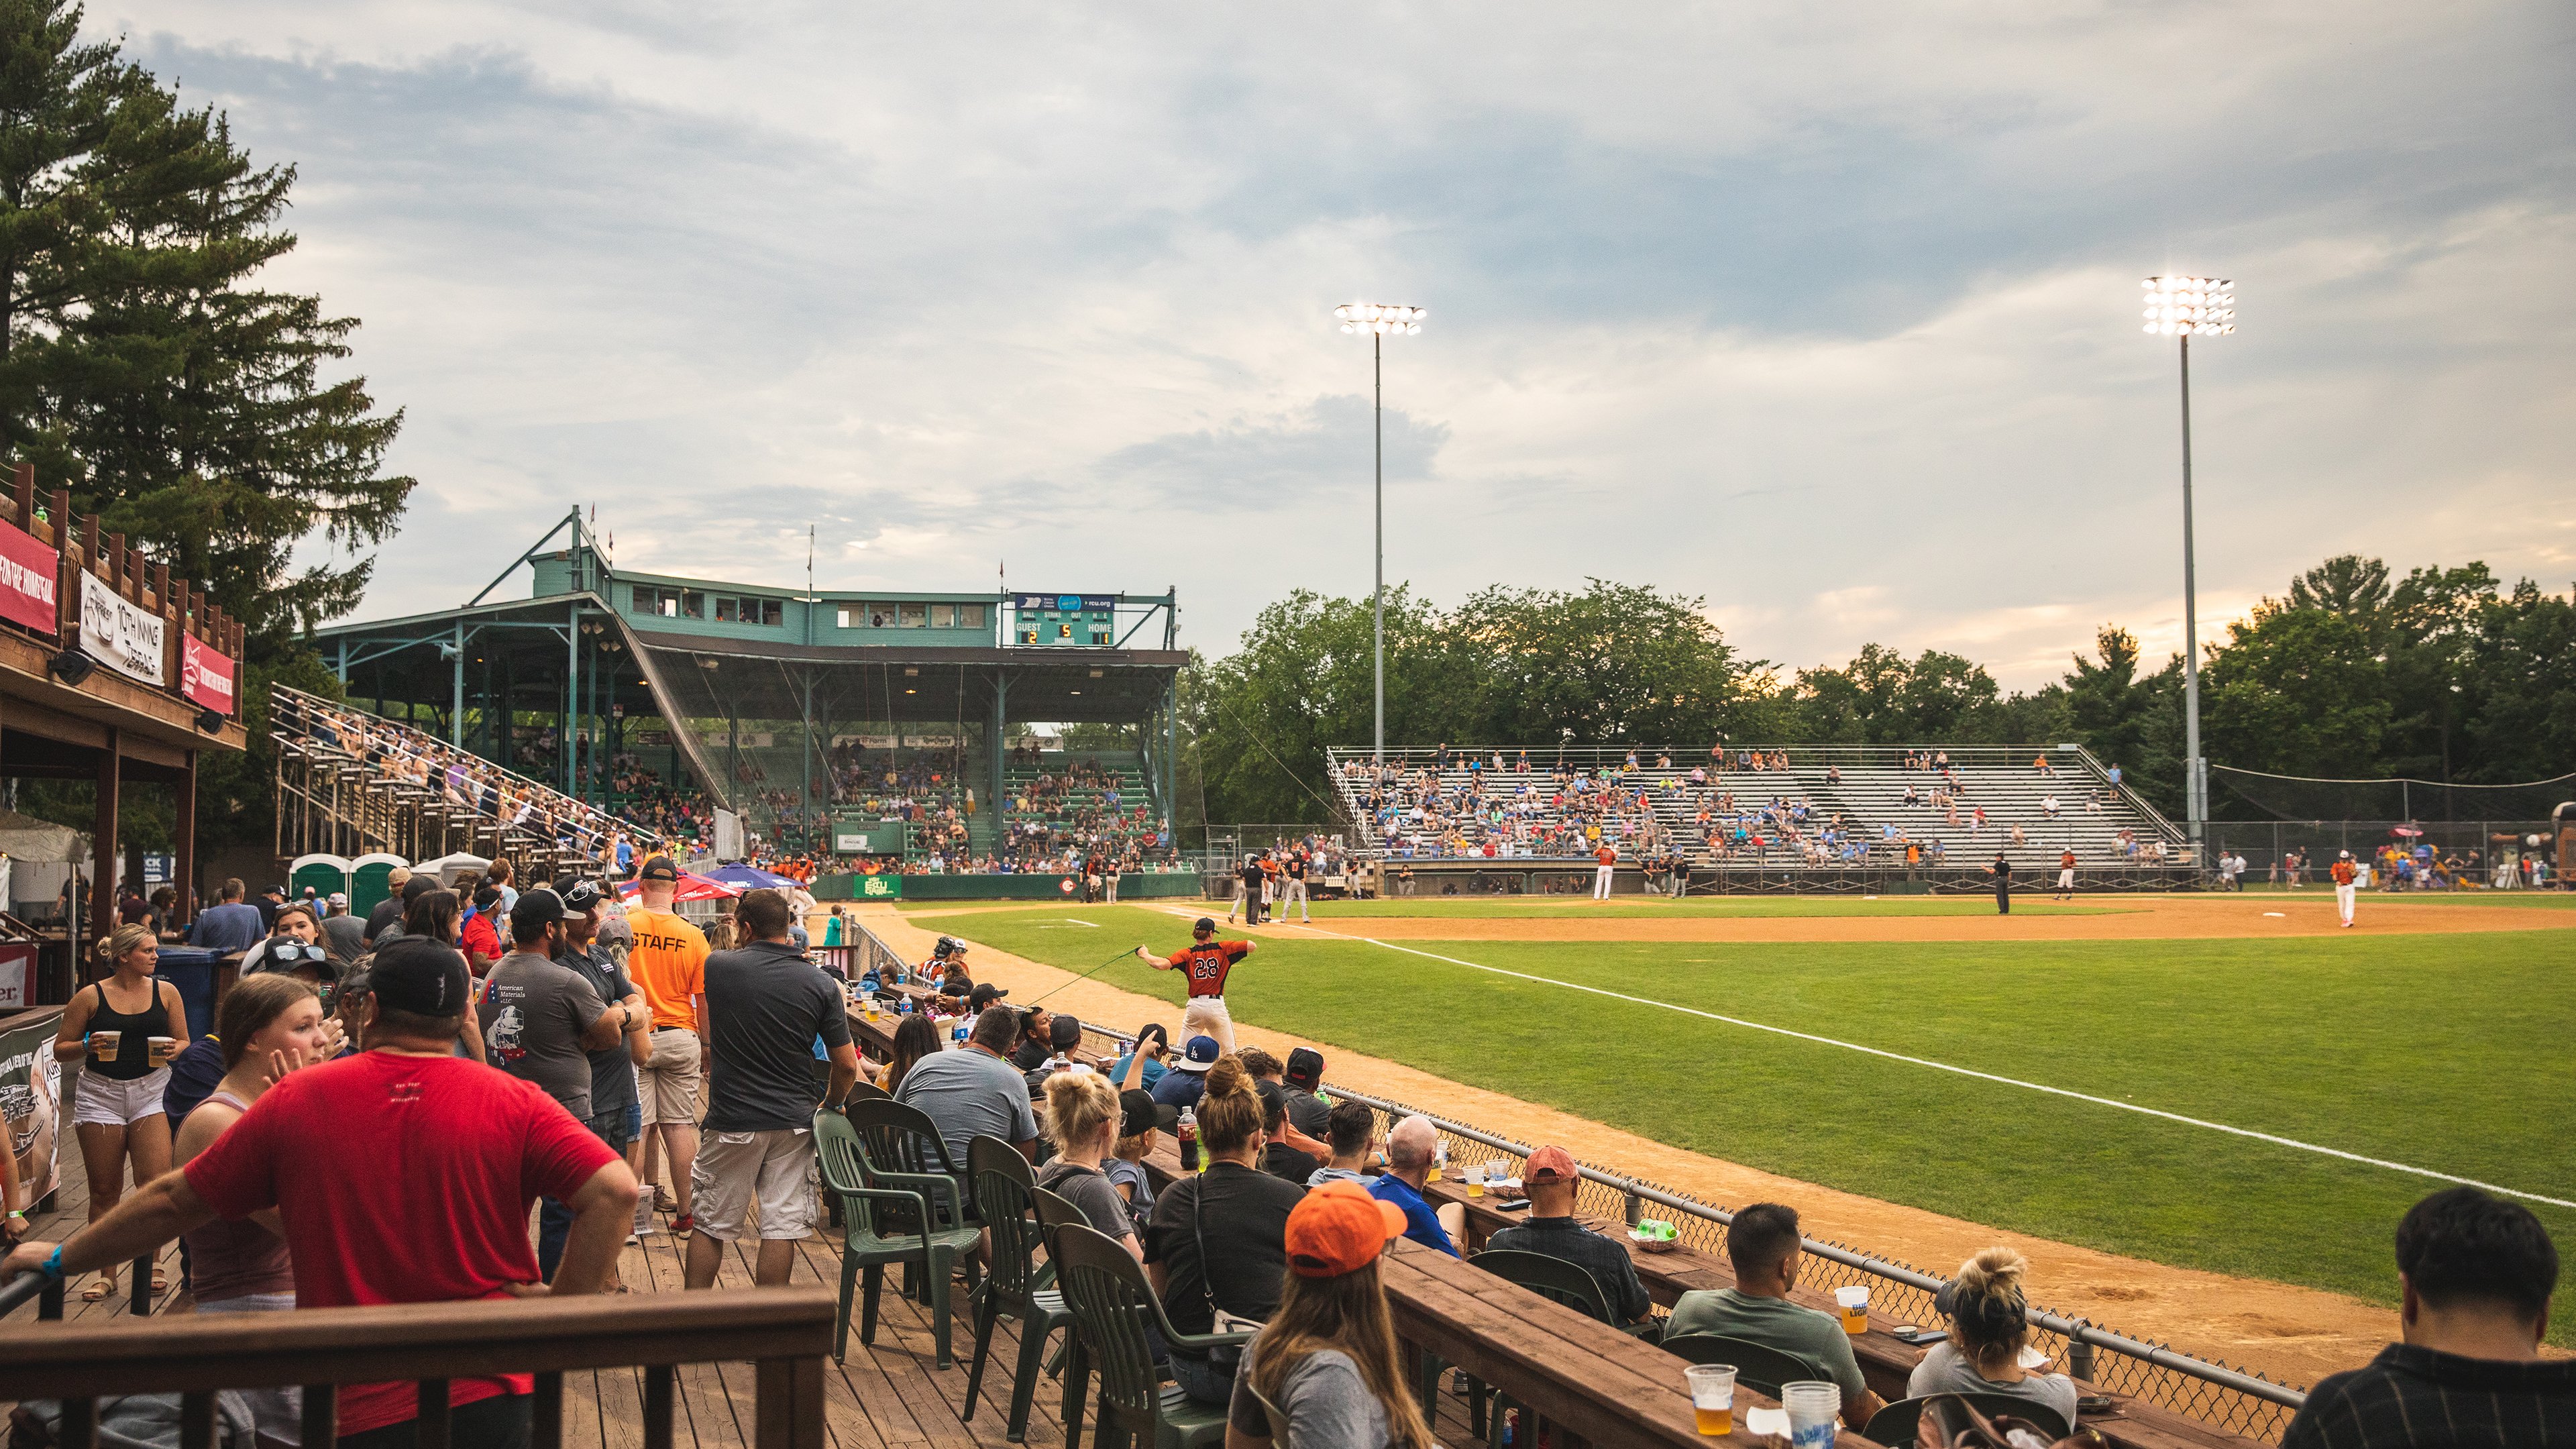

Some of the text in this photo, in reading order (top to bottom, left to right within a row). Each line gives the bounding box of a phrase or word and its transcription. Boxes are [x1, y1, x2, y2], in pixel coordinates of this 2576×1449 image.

[11, 561, 23, 592] THE
[117, 603, 136, 641] 10TH
[1016, 623, 1041, 631] GUEST
[1063, 625, 1071, 637] 5
[1088, 624, 1112, 633] HOME
[1029, 631, 1037, 644] 2
[1104, 633, 1109, 644] 1
[865, 881, 888, 889] EAU
[633, 932, 686, 953] STAFF
[1194, 957, 1219, 979] 28
[1852, 1302, 1867, 1310] BUD
[1849, 1308, 1868, 1318] LIGH
